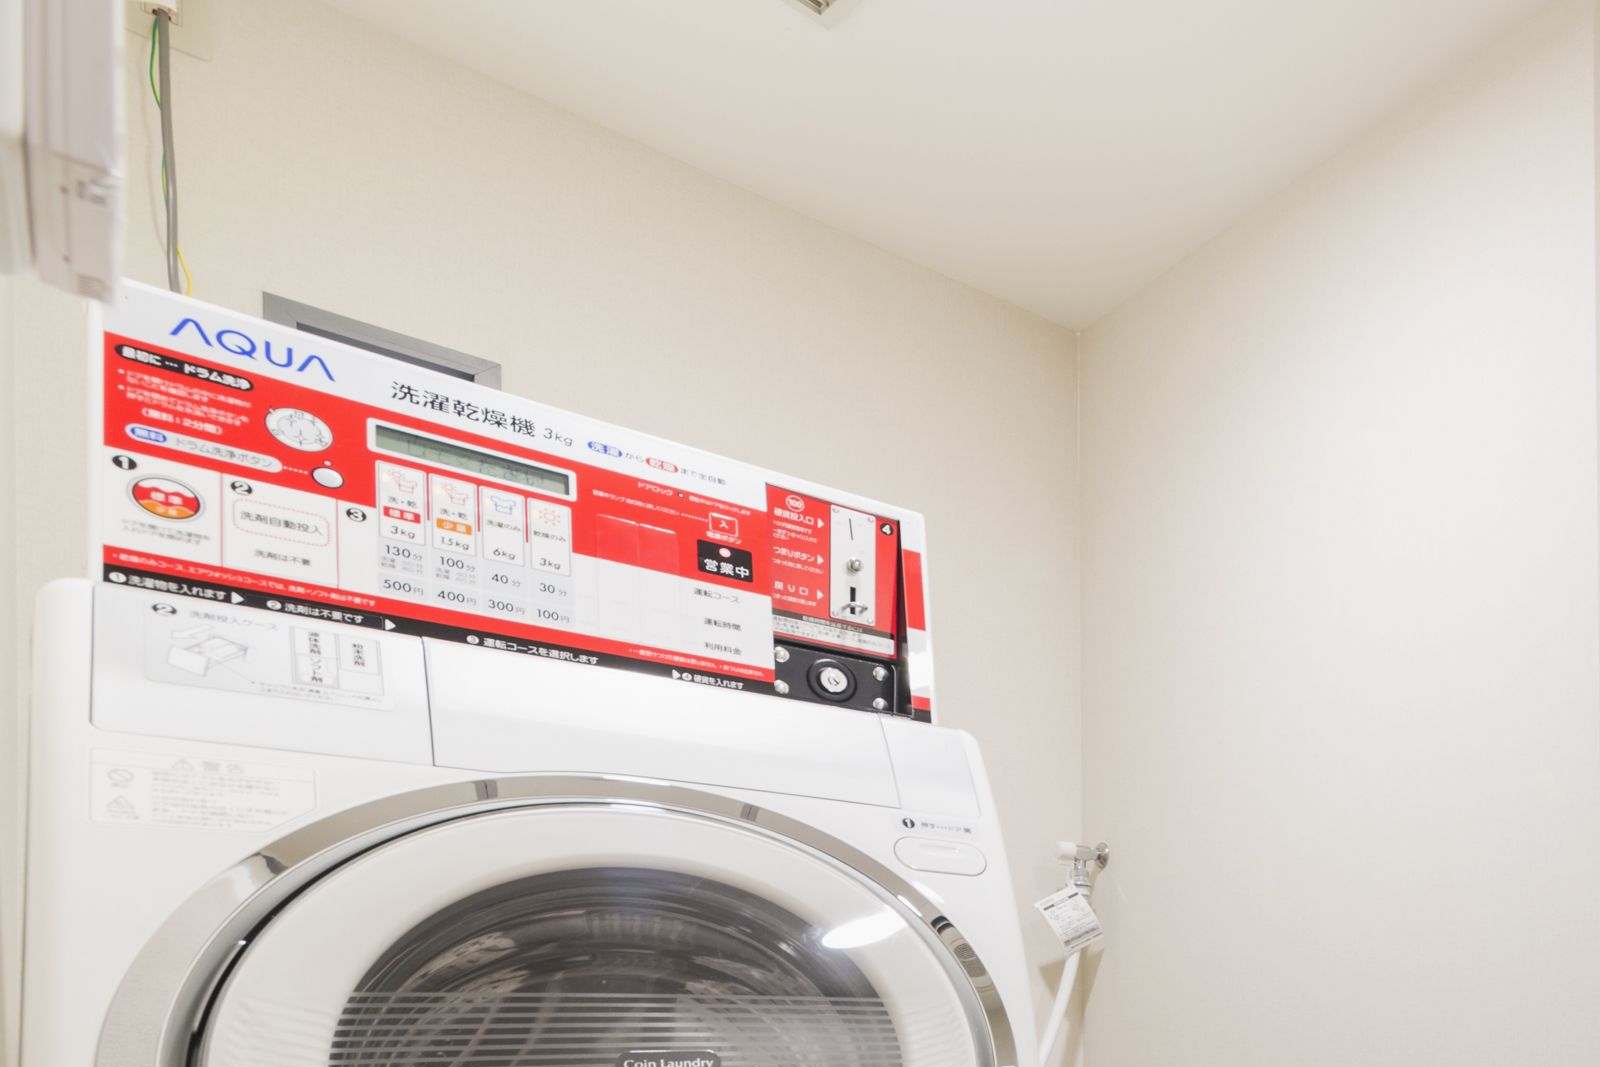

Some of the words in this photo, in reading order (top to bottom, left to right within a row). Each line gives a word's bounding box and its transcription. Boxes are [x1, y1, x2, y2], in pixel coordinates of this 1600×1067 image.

[170, 318, 336, 382] AQUA
[391, 380, 535, 437] 洗濯乾燥機
[543, 426, 573, 447] 3kg
[240, 510, 322, 536] 洗剤自動投入
[718, 519, 728, 529] 入
[881, 522, 892, 535] 4
[390, 525, 415, 540] 3kg
[493, 547, 515, 561] 6kg
[772, 545, 814, 562] つまりボタン
[539, 557, 560, 570] 3kg
[704, 557, 749, 579] 営業中
[128, 574, 226, 601] 洗濯物を入れます
[694, 587, 738, 603] 運転コース
[285, 601, 363, 625] 洗剤は不要です
[483, 636, 598, 666] 運転コースを選択します
[704, 641, 741, 656] 利用料金
[693, 673, 743, 690] 硬貨を入れます
